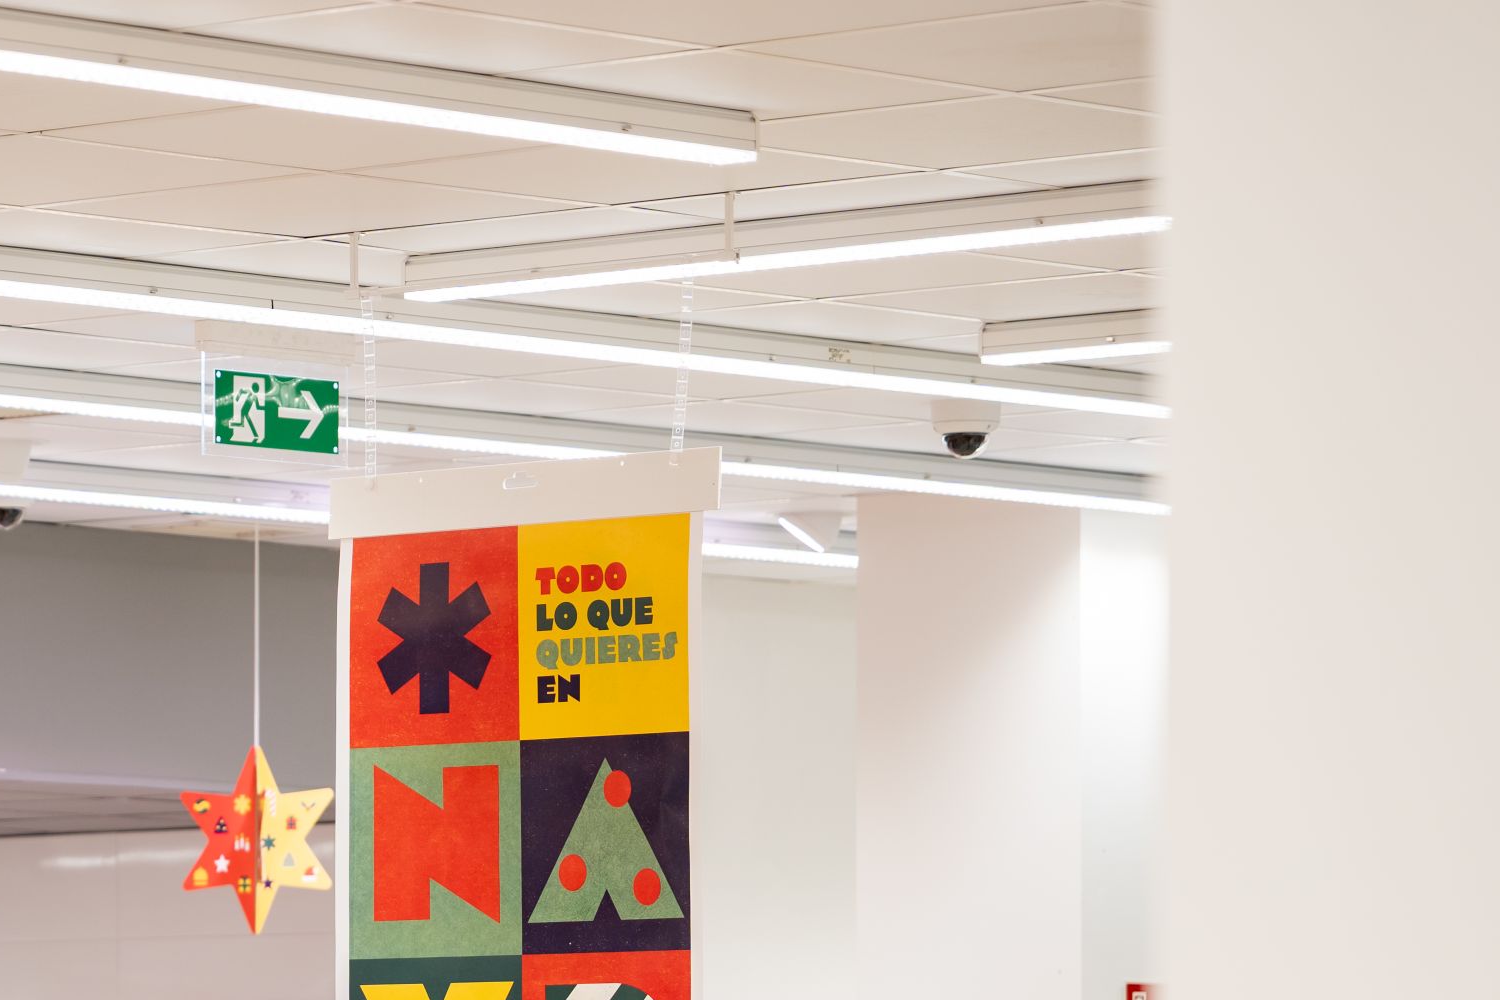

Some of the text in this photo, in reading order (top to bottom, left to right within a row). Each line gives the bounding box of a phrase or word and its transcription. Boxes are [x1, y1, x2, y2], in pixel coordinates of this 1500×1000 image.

[535, 562, 628, 596] TODO
[536, 596, 654, 632] LO QUE
[535, 631, 678, 670] QUIERES
[537, 673, 581, 704] EN
